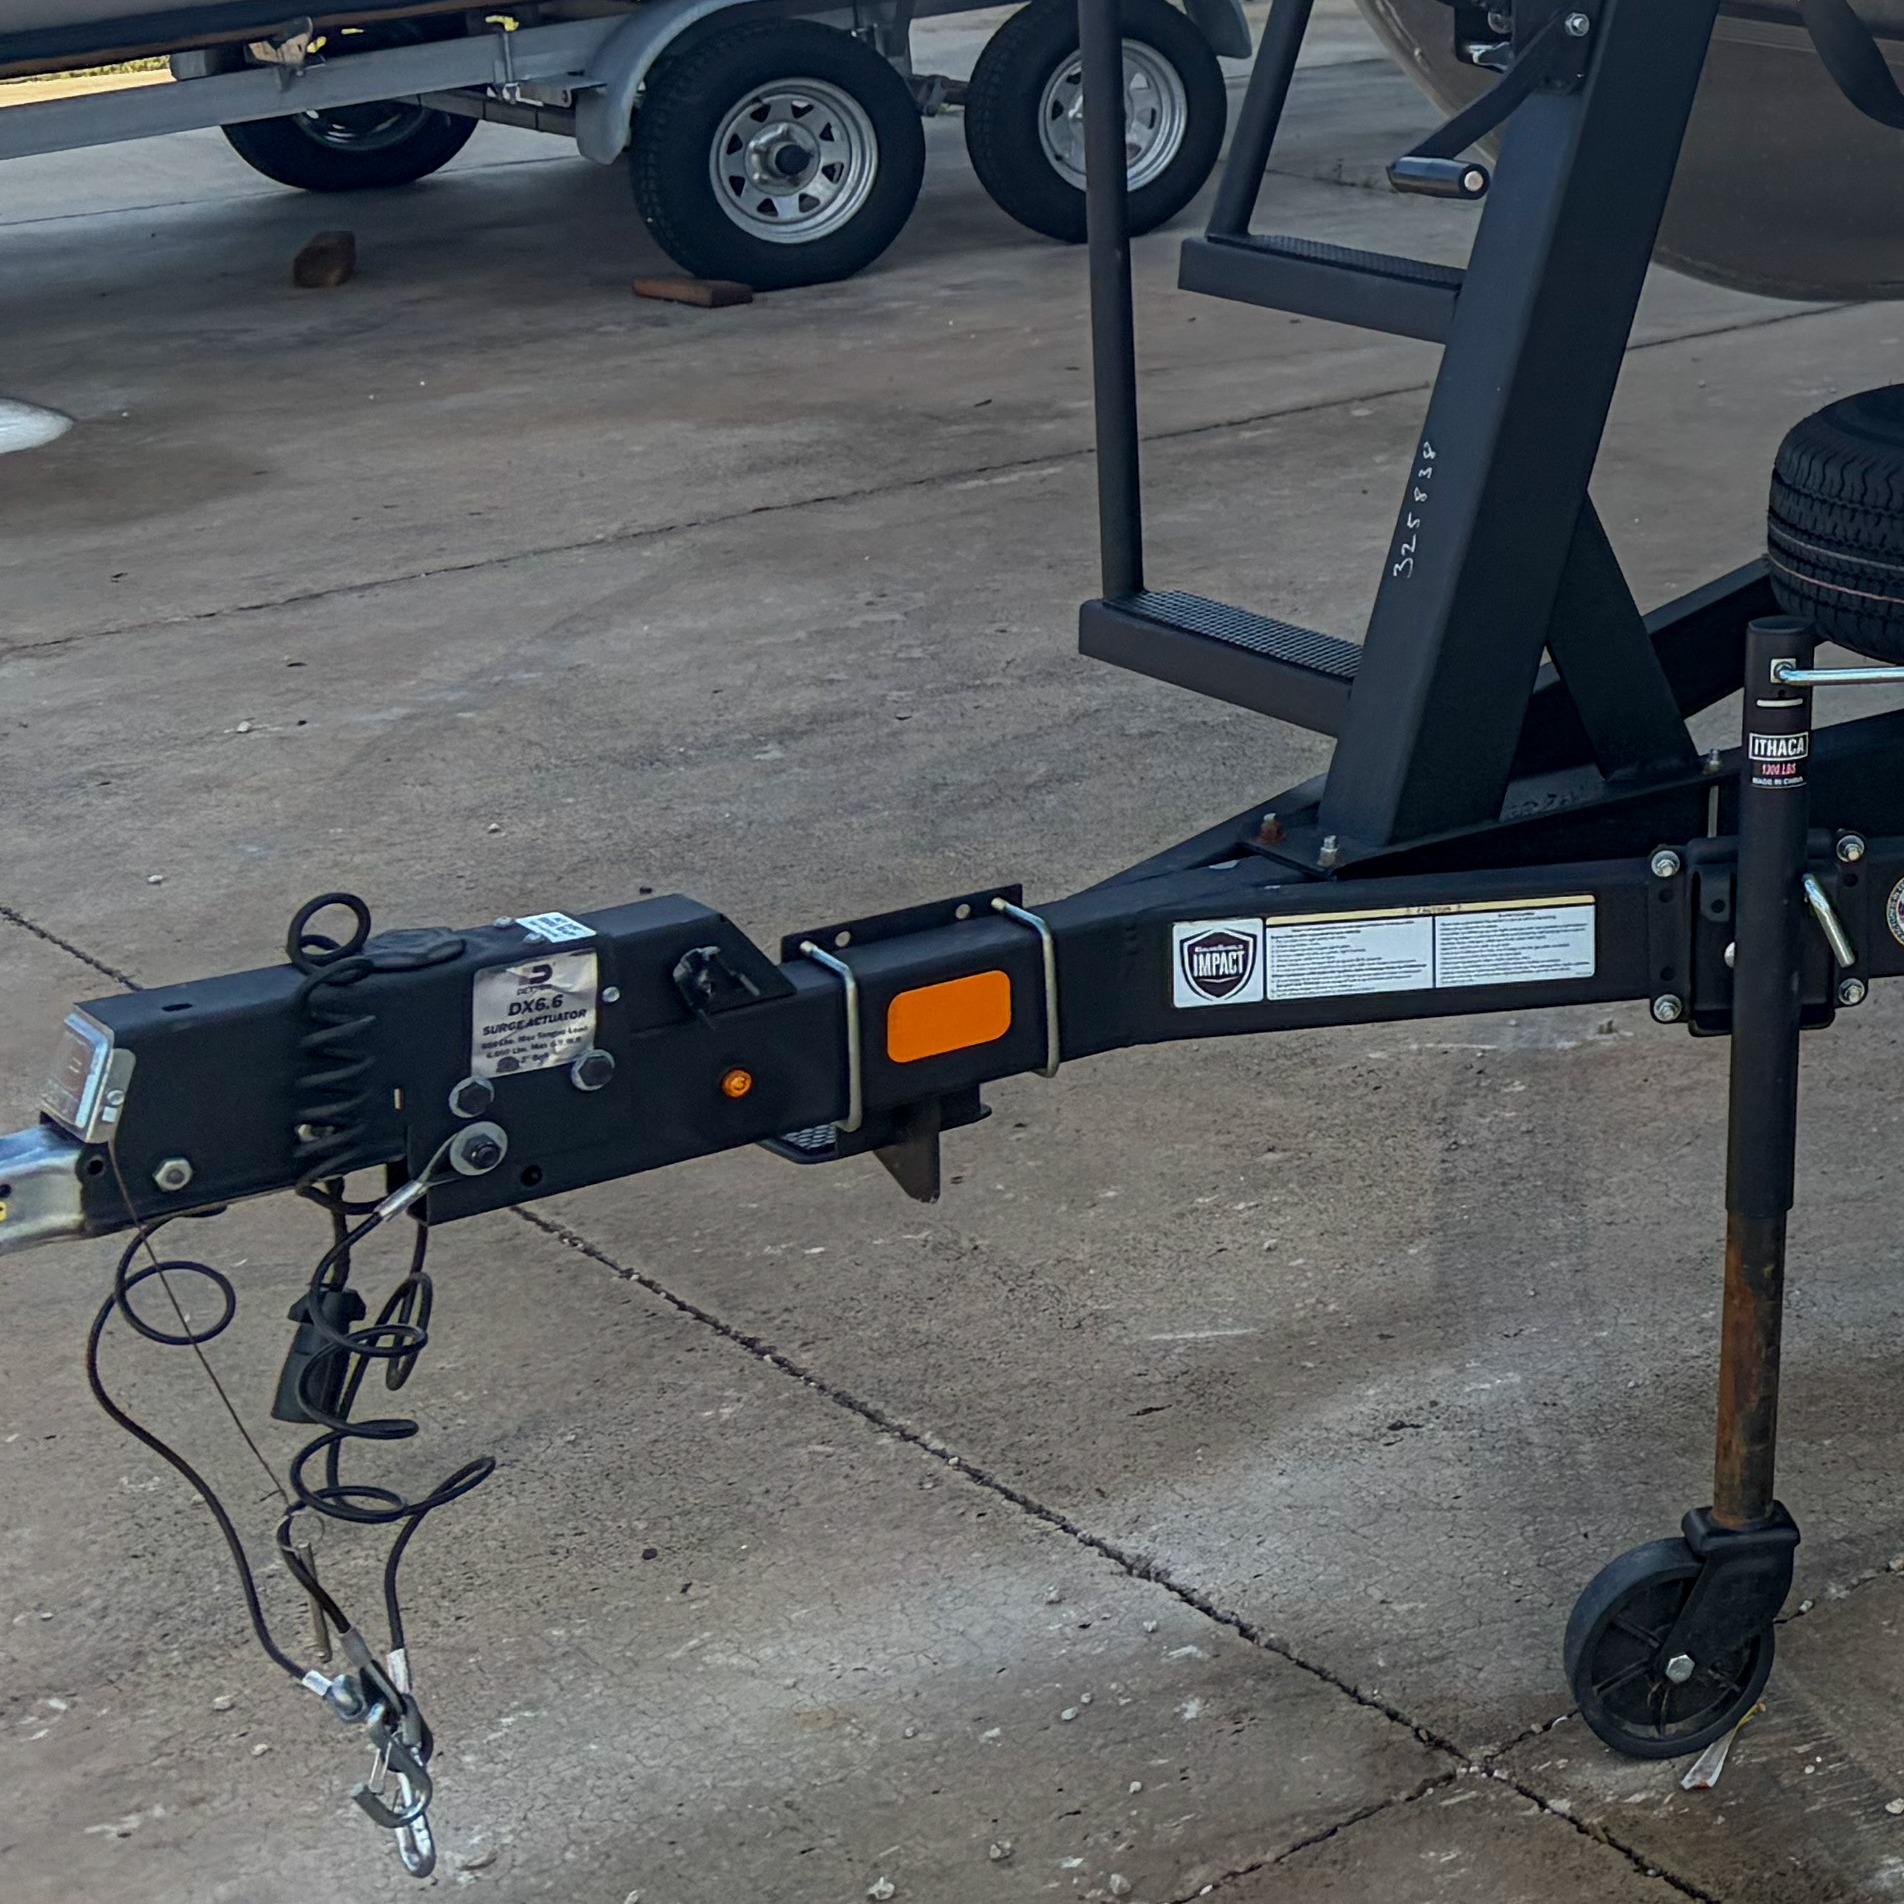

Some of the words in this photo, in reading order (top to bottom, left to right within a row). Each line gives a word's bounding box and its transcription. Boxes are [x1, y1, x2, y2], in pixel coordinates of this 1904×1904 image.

[1753, 737, 1805, 757] ITHACA
[1193, 950, 1245, 977] IMPACT
[507, 994, 564, 1017] DX6.6
[525, 1008, 587, 1029] ACTUATOR
